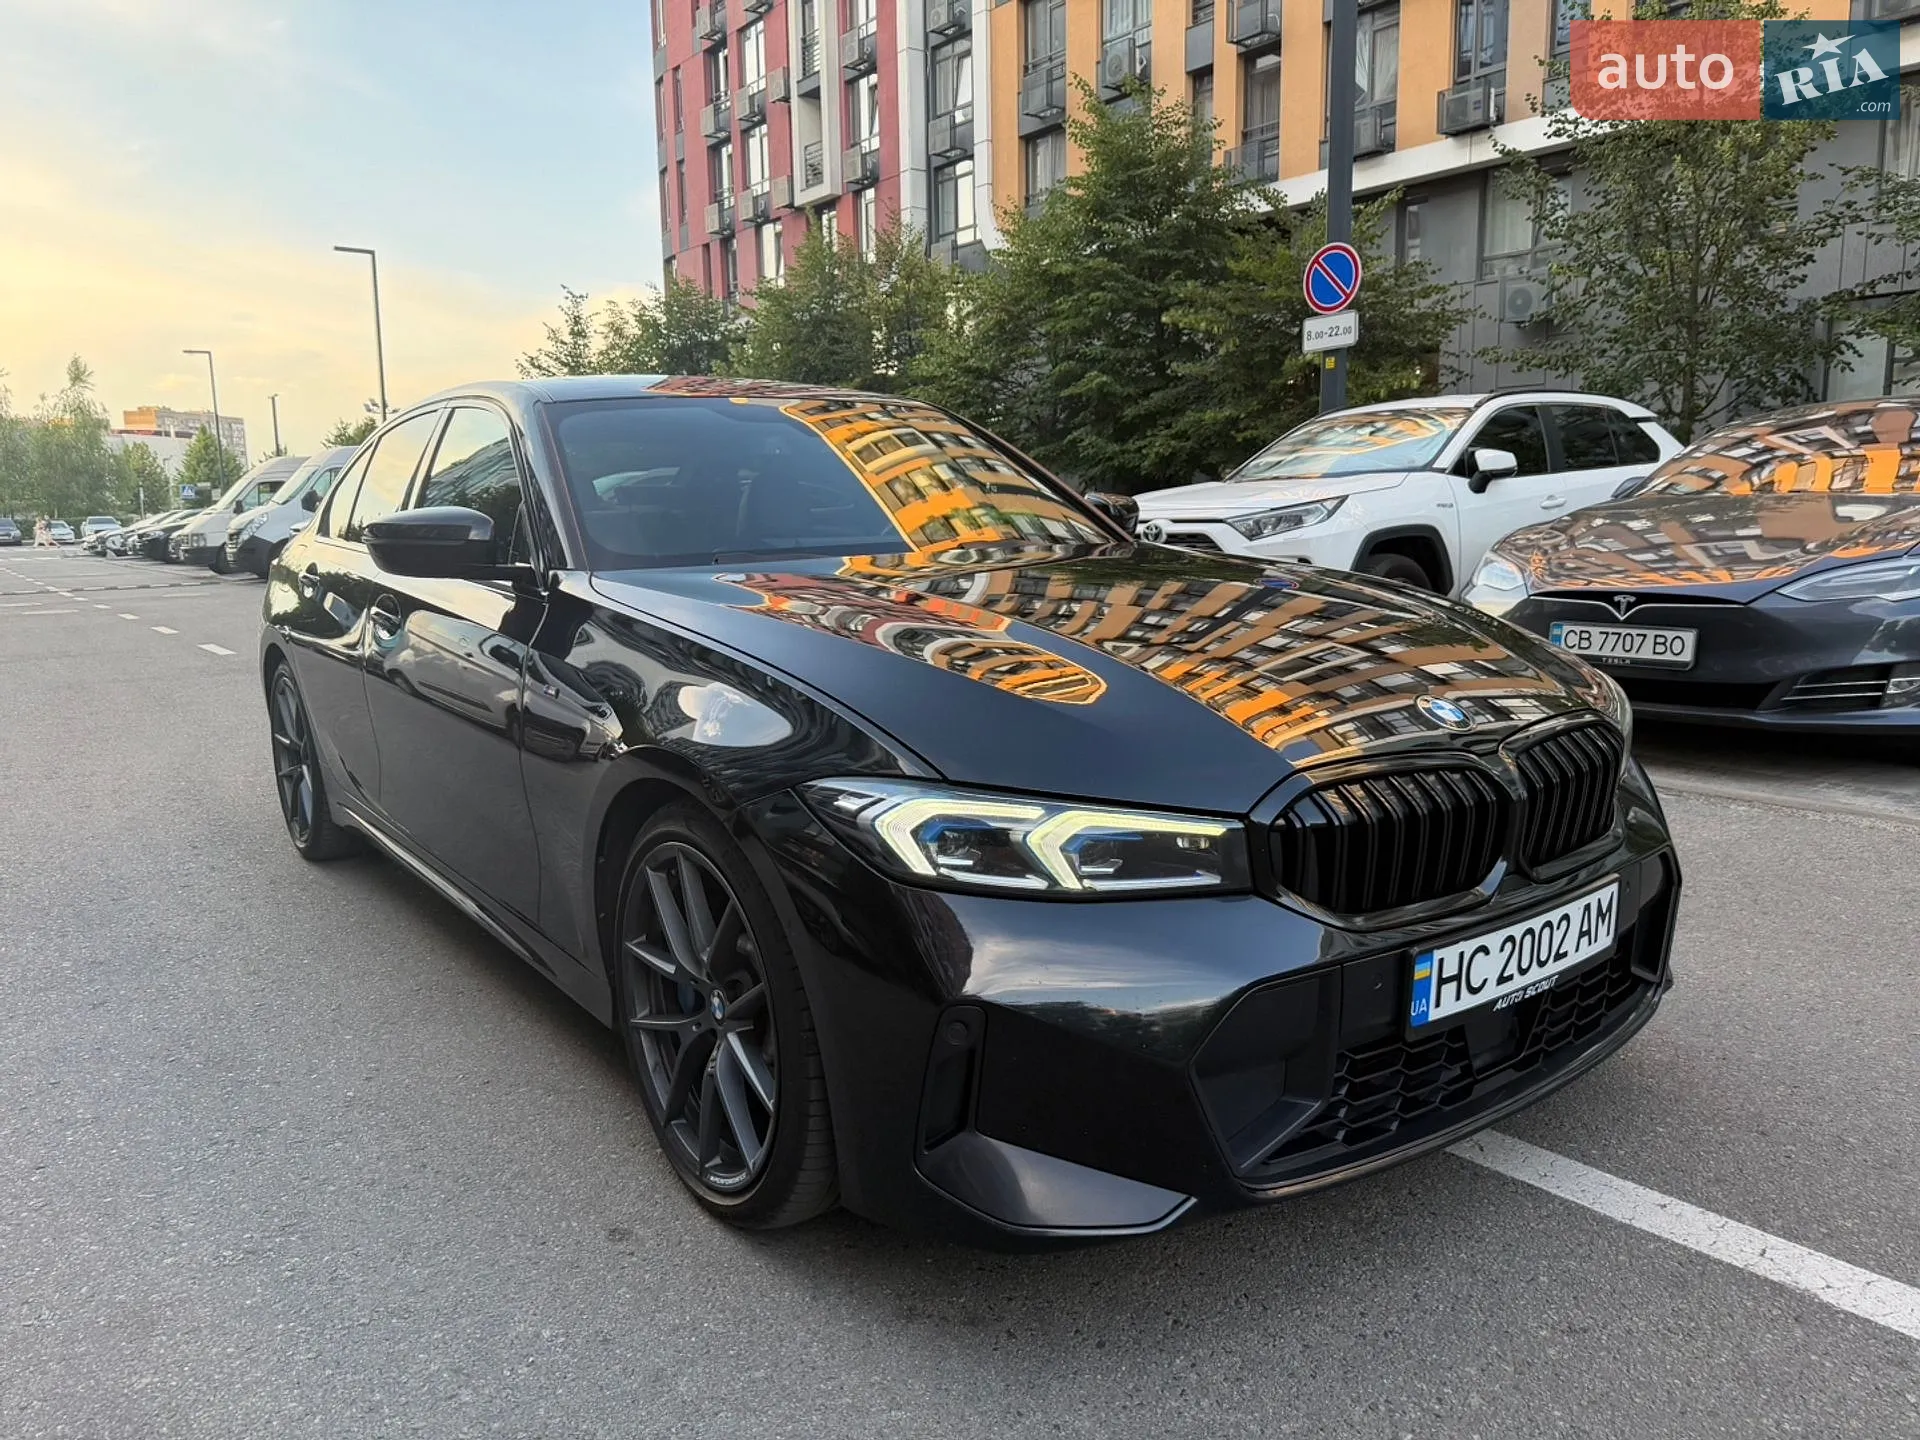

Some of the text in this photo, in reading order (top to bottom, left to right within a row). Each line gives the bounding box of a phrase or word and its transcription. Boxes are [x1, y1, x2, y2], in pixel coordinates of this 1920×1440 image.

[1306, 325, 1353, 341] 8.00-22.00
[1564, 629, 1686, 656] CB 7707 BO
[1434, 891, 1615, 1009] HC 2002 AM
[1410, 998, 1428, 1016] UA
[1492, 975, 1559, 1012] AUTO SCOUT
